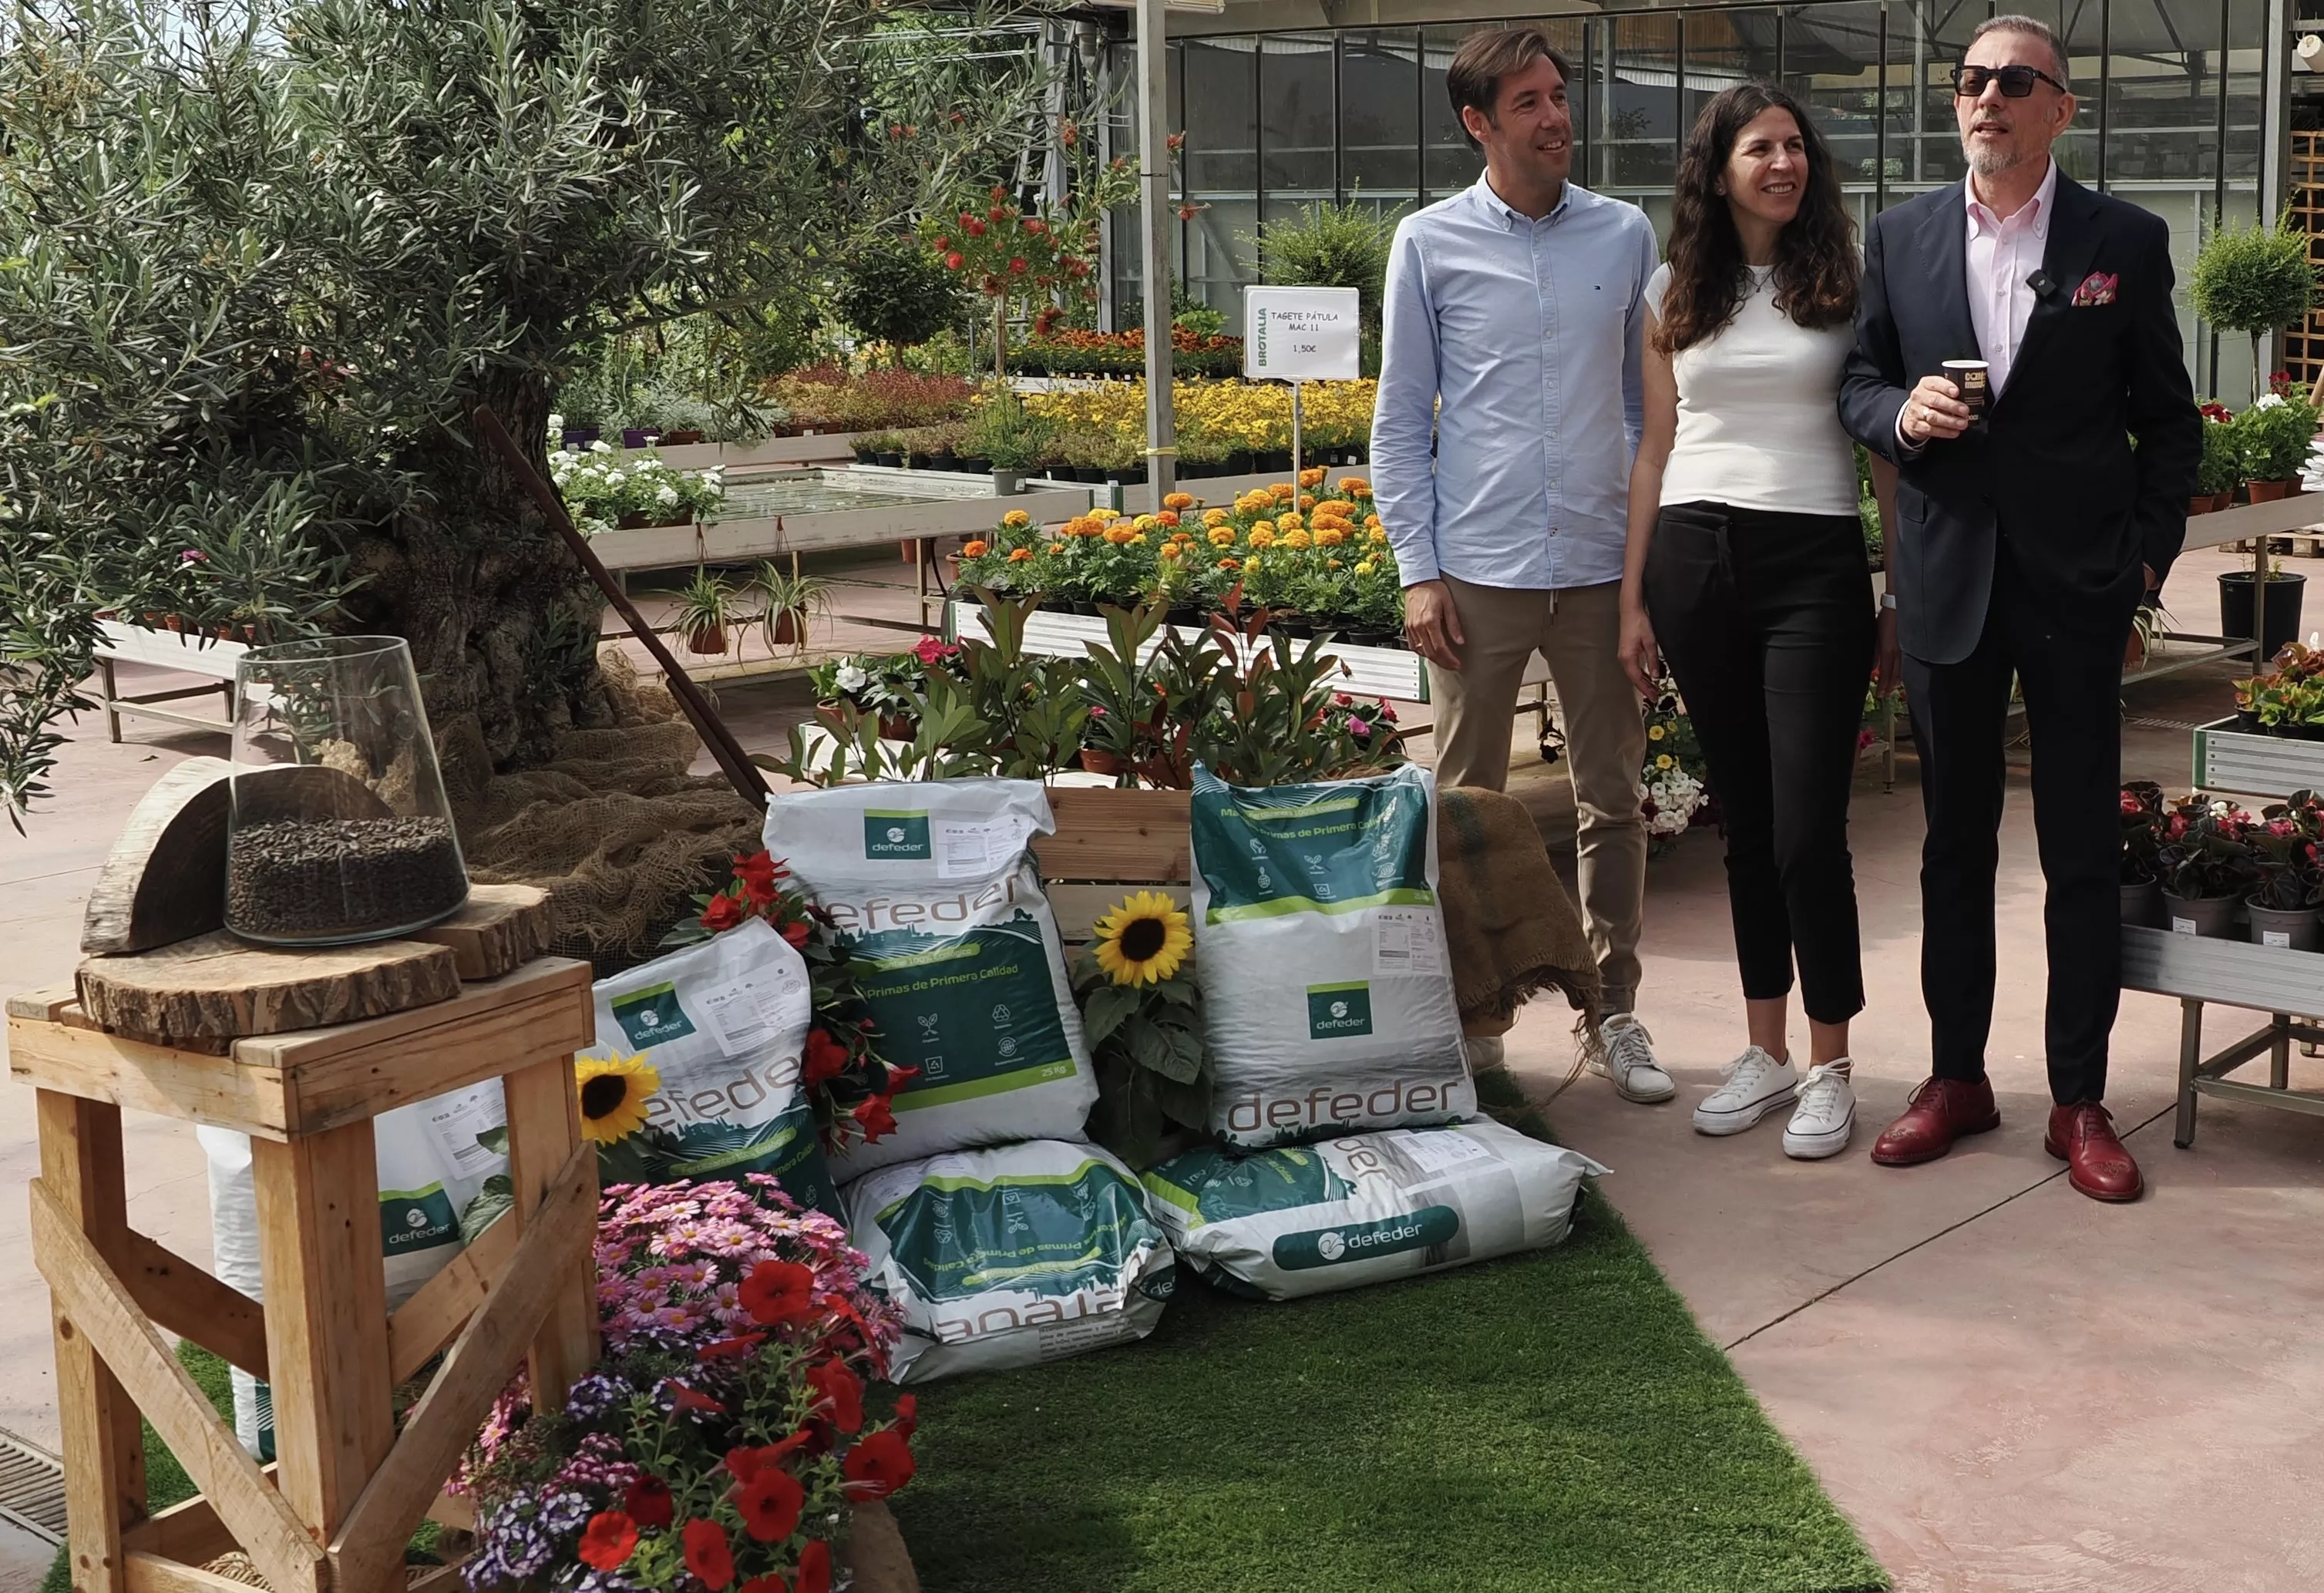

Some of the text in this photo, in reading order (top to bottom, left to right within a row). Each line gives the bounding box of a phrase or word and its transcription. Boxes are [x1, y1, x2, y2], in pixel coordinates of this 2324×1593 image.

[1271, 311, 1339, 321] TAGETE PÁTULA
[1258, 308, 1267, 367] BROTALIA
[1293, 344, 1317, 354] 1,50€
[1297, 828, 1311, 837] de
[1313, 822, 1357, 836] Primera
[872, 842, 923, 852] defeder
[823, 874, 1017, 929] efeder
[866, 963, 1019, 1000] Primas de Primera Calidad
[634, 1019, 684, 1040] defeder
[1316, 1017, 1366, 1030] defeder
[1041, 1065, 1067, 1077] 25 Kg
[641, 1055, 800, 1131] efede
[1228, 1080, 1458, 1133] defeder
[388, 1222, 451, 1245] defeder
[1348, 1223, 1424, 1249] defeder
[1017, 1245, 1035, 1256] de
[1036, 1242, 1082, 1252] Primas
